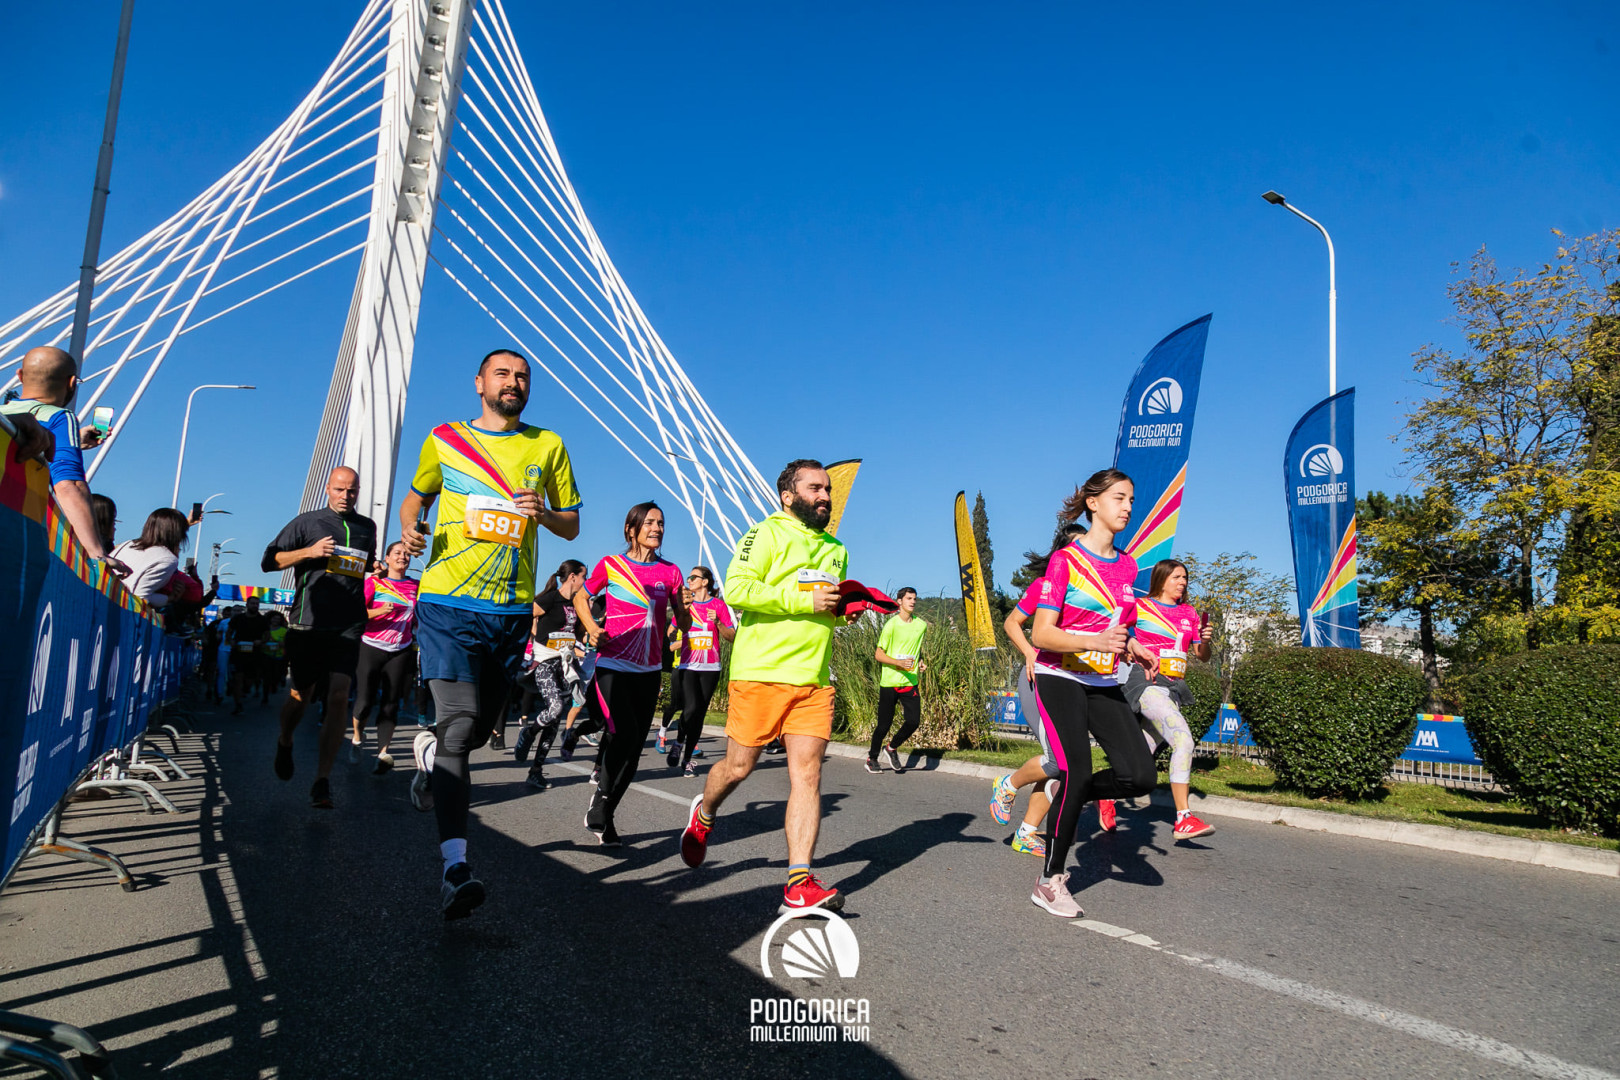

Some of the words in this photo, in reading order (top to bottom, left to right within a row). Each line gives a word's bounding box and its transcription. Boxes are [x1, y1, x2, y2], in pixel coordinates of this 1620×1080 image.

[1129, 423, 1183, 438] PODGORICA
[1128, 438, 1166, 448] MILLENNIUM
[1167, 437, 1181, 447] RUN
[1297, 482, 1348, 498] PODGORICA
[1298, 494, 1336, 506] MILLENNIUM
[480, 512, 521, 539] 591
[740, 528, 759, 562] EAGLE
[339, 558, 365, 573] 1170
[274, 590, 294, 603] ST
[693, 638, 712, 647] 478
[1078, 651, 1112, 666] 249
[1170, 660, 1186, 673] 293
